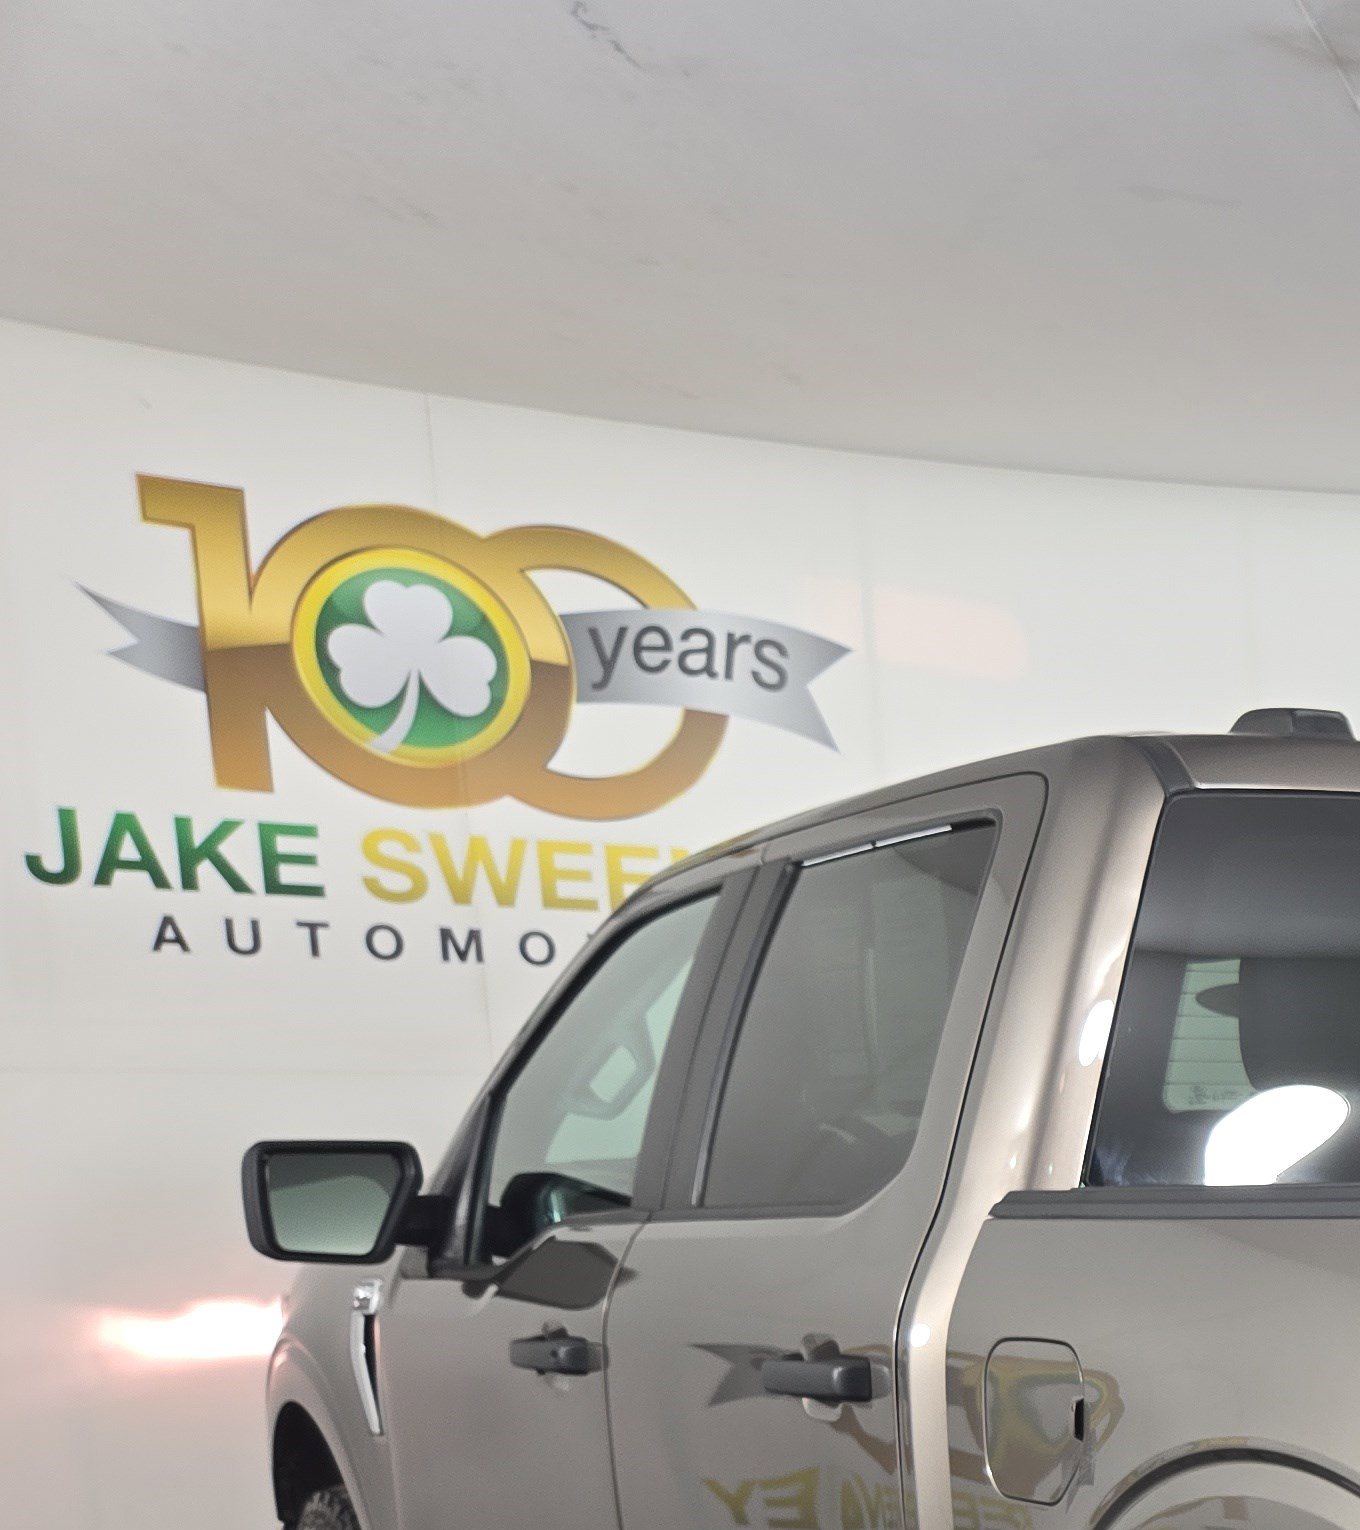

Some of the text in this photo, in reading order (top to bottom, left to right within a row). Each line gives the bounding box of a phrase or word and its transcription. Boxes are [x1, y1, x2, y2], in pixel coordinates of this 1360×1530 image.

[587, 616, 791, 693] years
[25, 808, 690, 912] JAKE SWEE
[152, 915, 557, 966] AUTOMO
